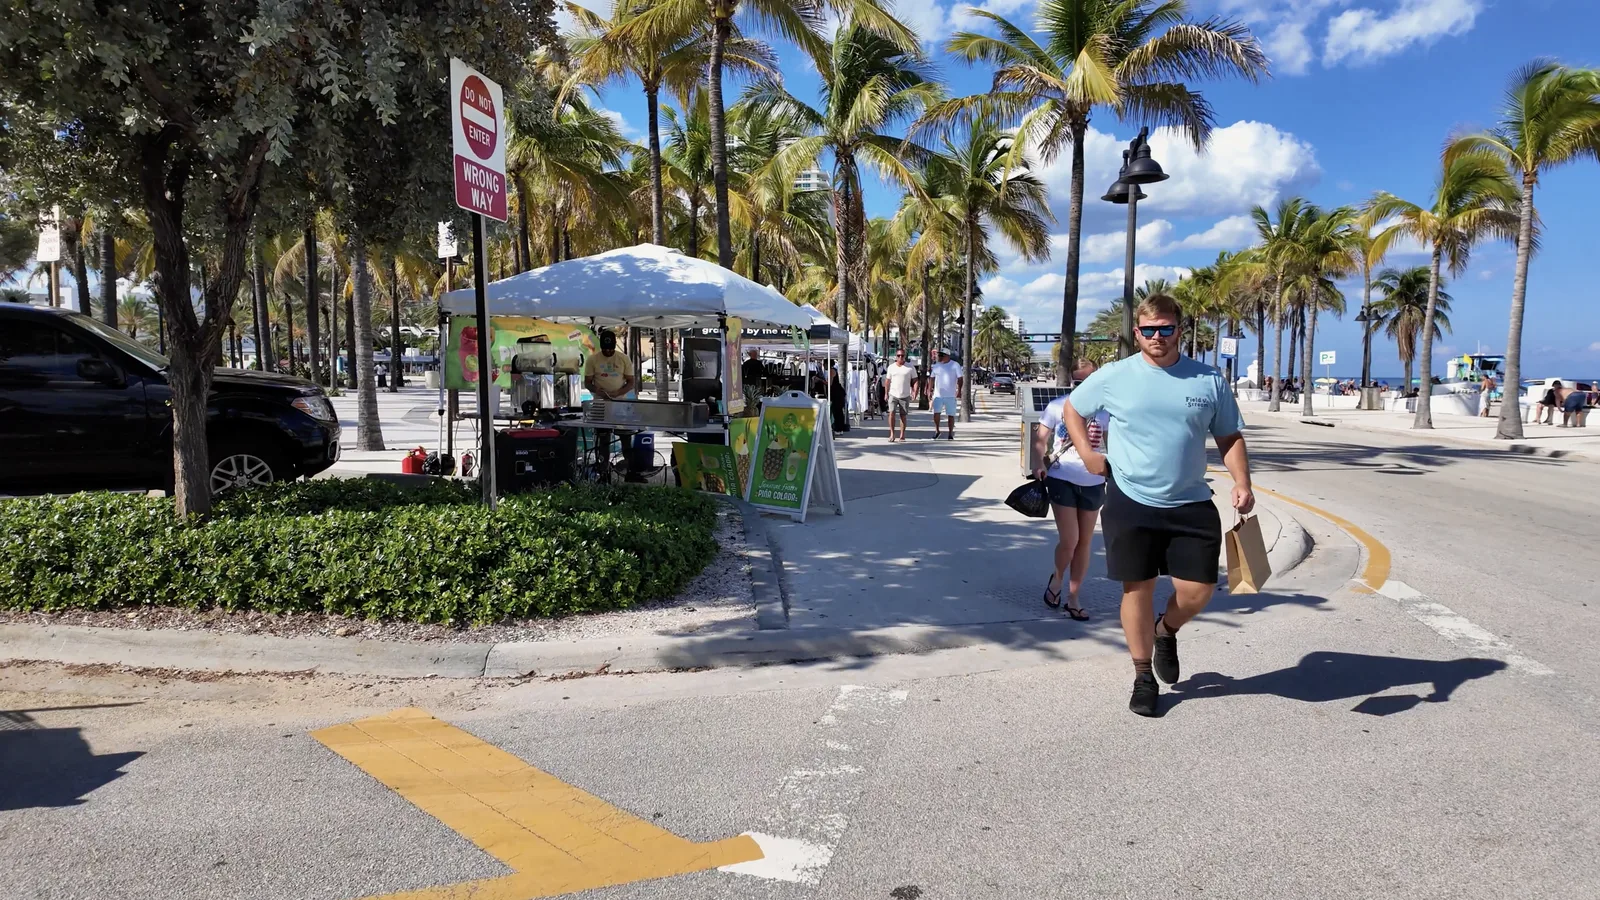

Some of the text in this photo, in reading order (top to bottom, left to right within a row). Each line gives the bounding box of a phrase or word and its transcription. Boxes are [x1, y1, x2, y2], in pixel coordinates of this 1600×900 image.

[465, 86, 492, 112] DO NOT
[469, 125, 491, 147] ENTER
[463, 161, 499, 193] WRONG
[471, 187, 494, 212] WAY
[747, 327, 760, 336] by
[762, 327, 778, 335] the
